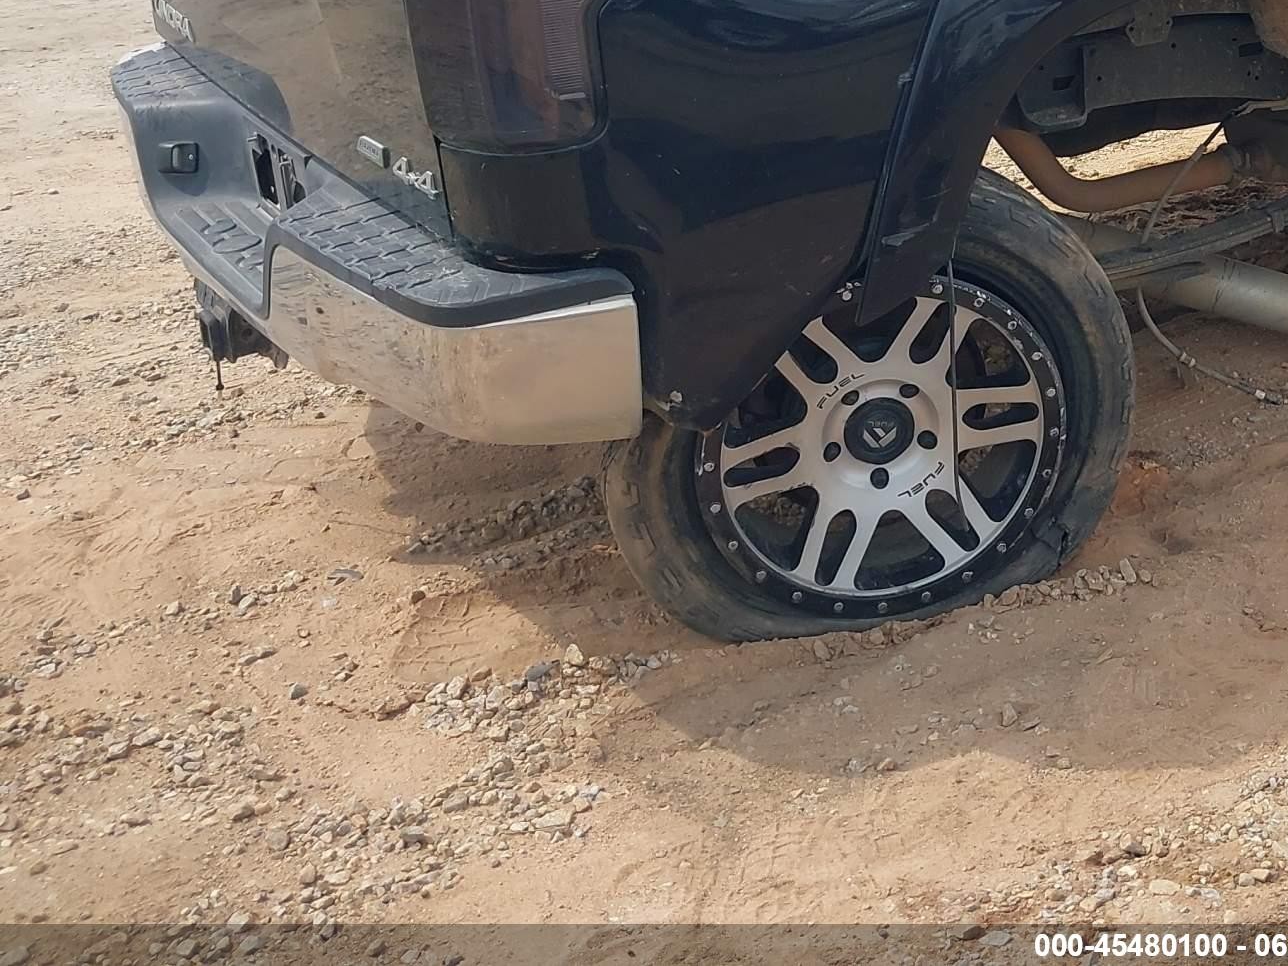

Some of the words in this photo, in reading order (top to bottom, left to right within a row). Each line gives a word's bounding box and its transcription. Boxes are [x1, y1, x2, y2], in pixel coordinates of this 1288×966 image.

[392, 156, 441, 200] 4x4
[816, 373, 865, 410] FUEL
[866, 420, 895, 429] FUEL
[897, 461, 945, 498] FUEL
